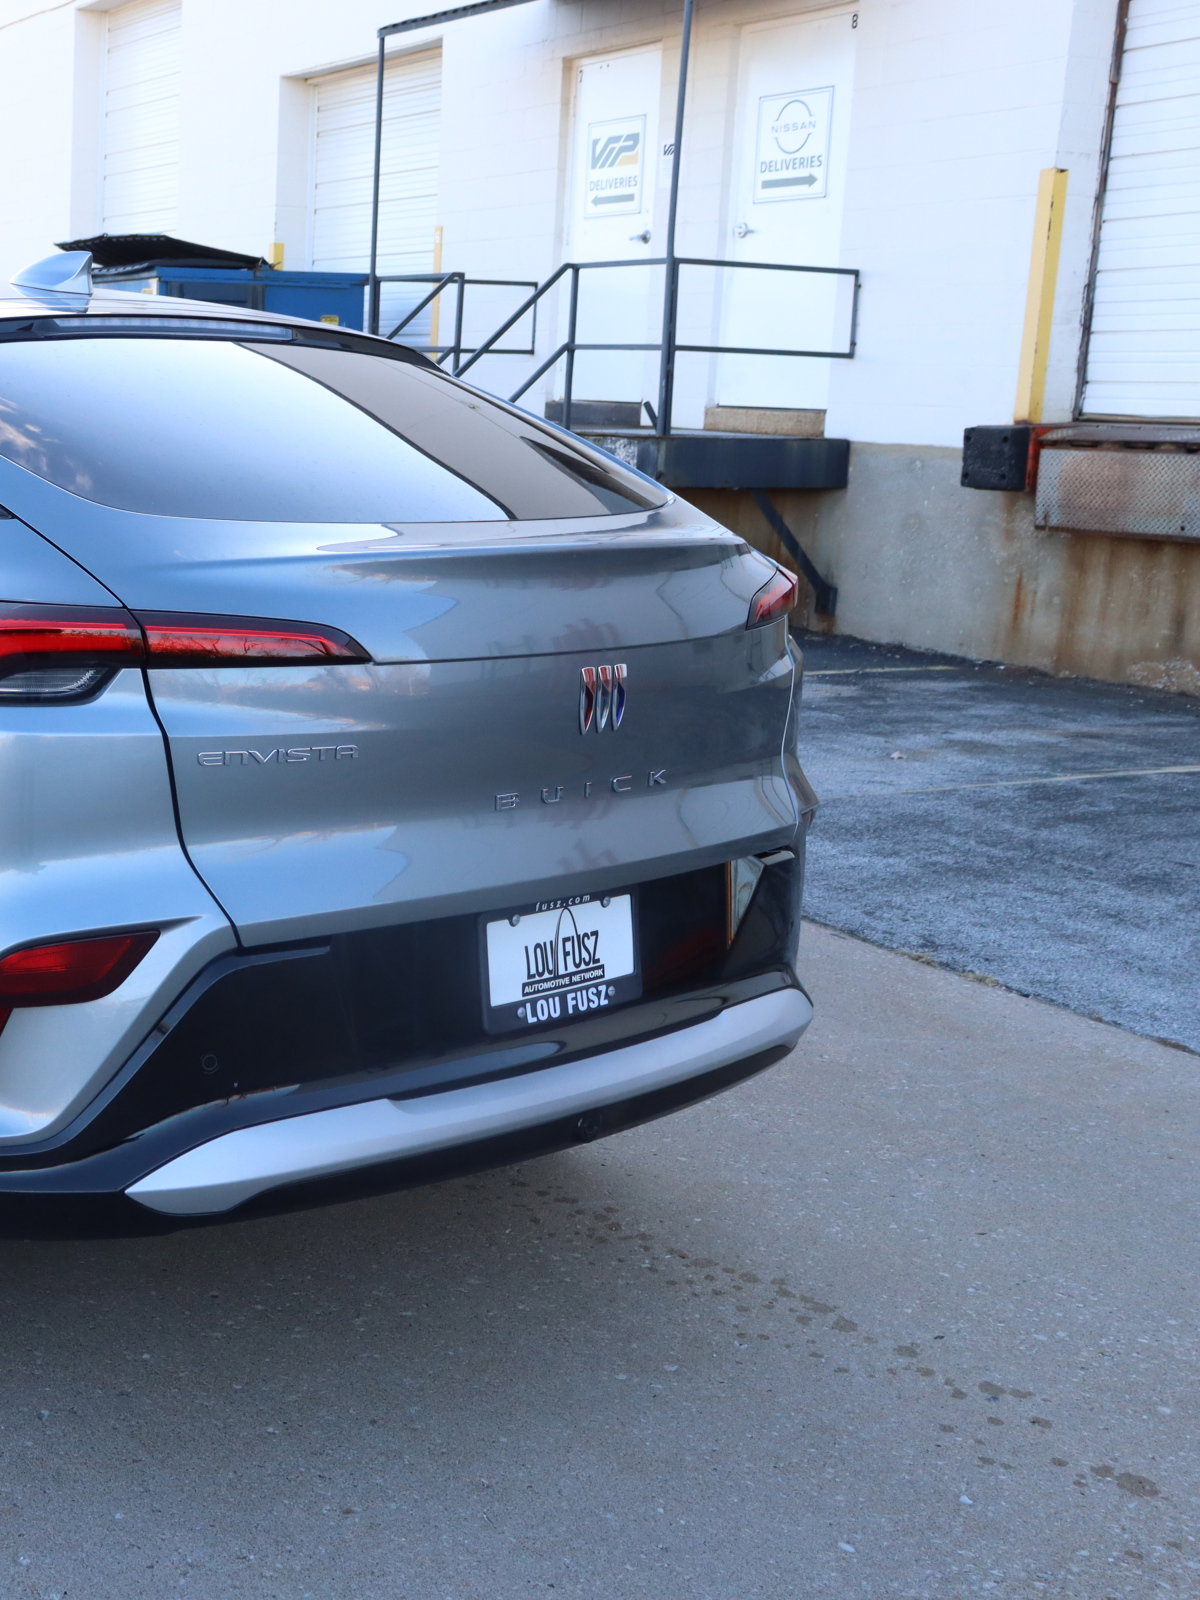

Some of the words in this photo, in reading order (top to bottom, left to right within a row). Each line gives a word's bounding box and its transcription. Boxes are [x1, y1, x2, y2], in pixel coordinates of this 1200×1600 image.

[851, 13, 859, 29] 8
[770, 119, 817, 134] NISSAN
[590, 132, 640, 170] VIP
[760, 155, 823, 174] DELIVERIES
[589, 175, 638, 192] DELIVERIES
[197, 743, 360, 767] ENVISTA
[494, 768, 669, 812] BUICK
[535, 894, 591, 912] fusz.com
[524, 939, 555, 980] LOU
[562, 930, 601, 972] FUSZ
[524, 976, 571, 994] AUTOMOTIVE
[571, 968, 604, 983] NETWORK
[525, 997, 561, 1024] LOU
[567, 985, 609, 1015] FUSZ
